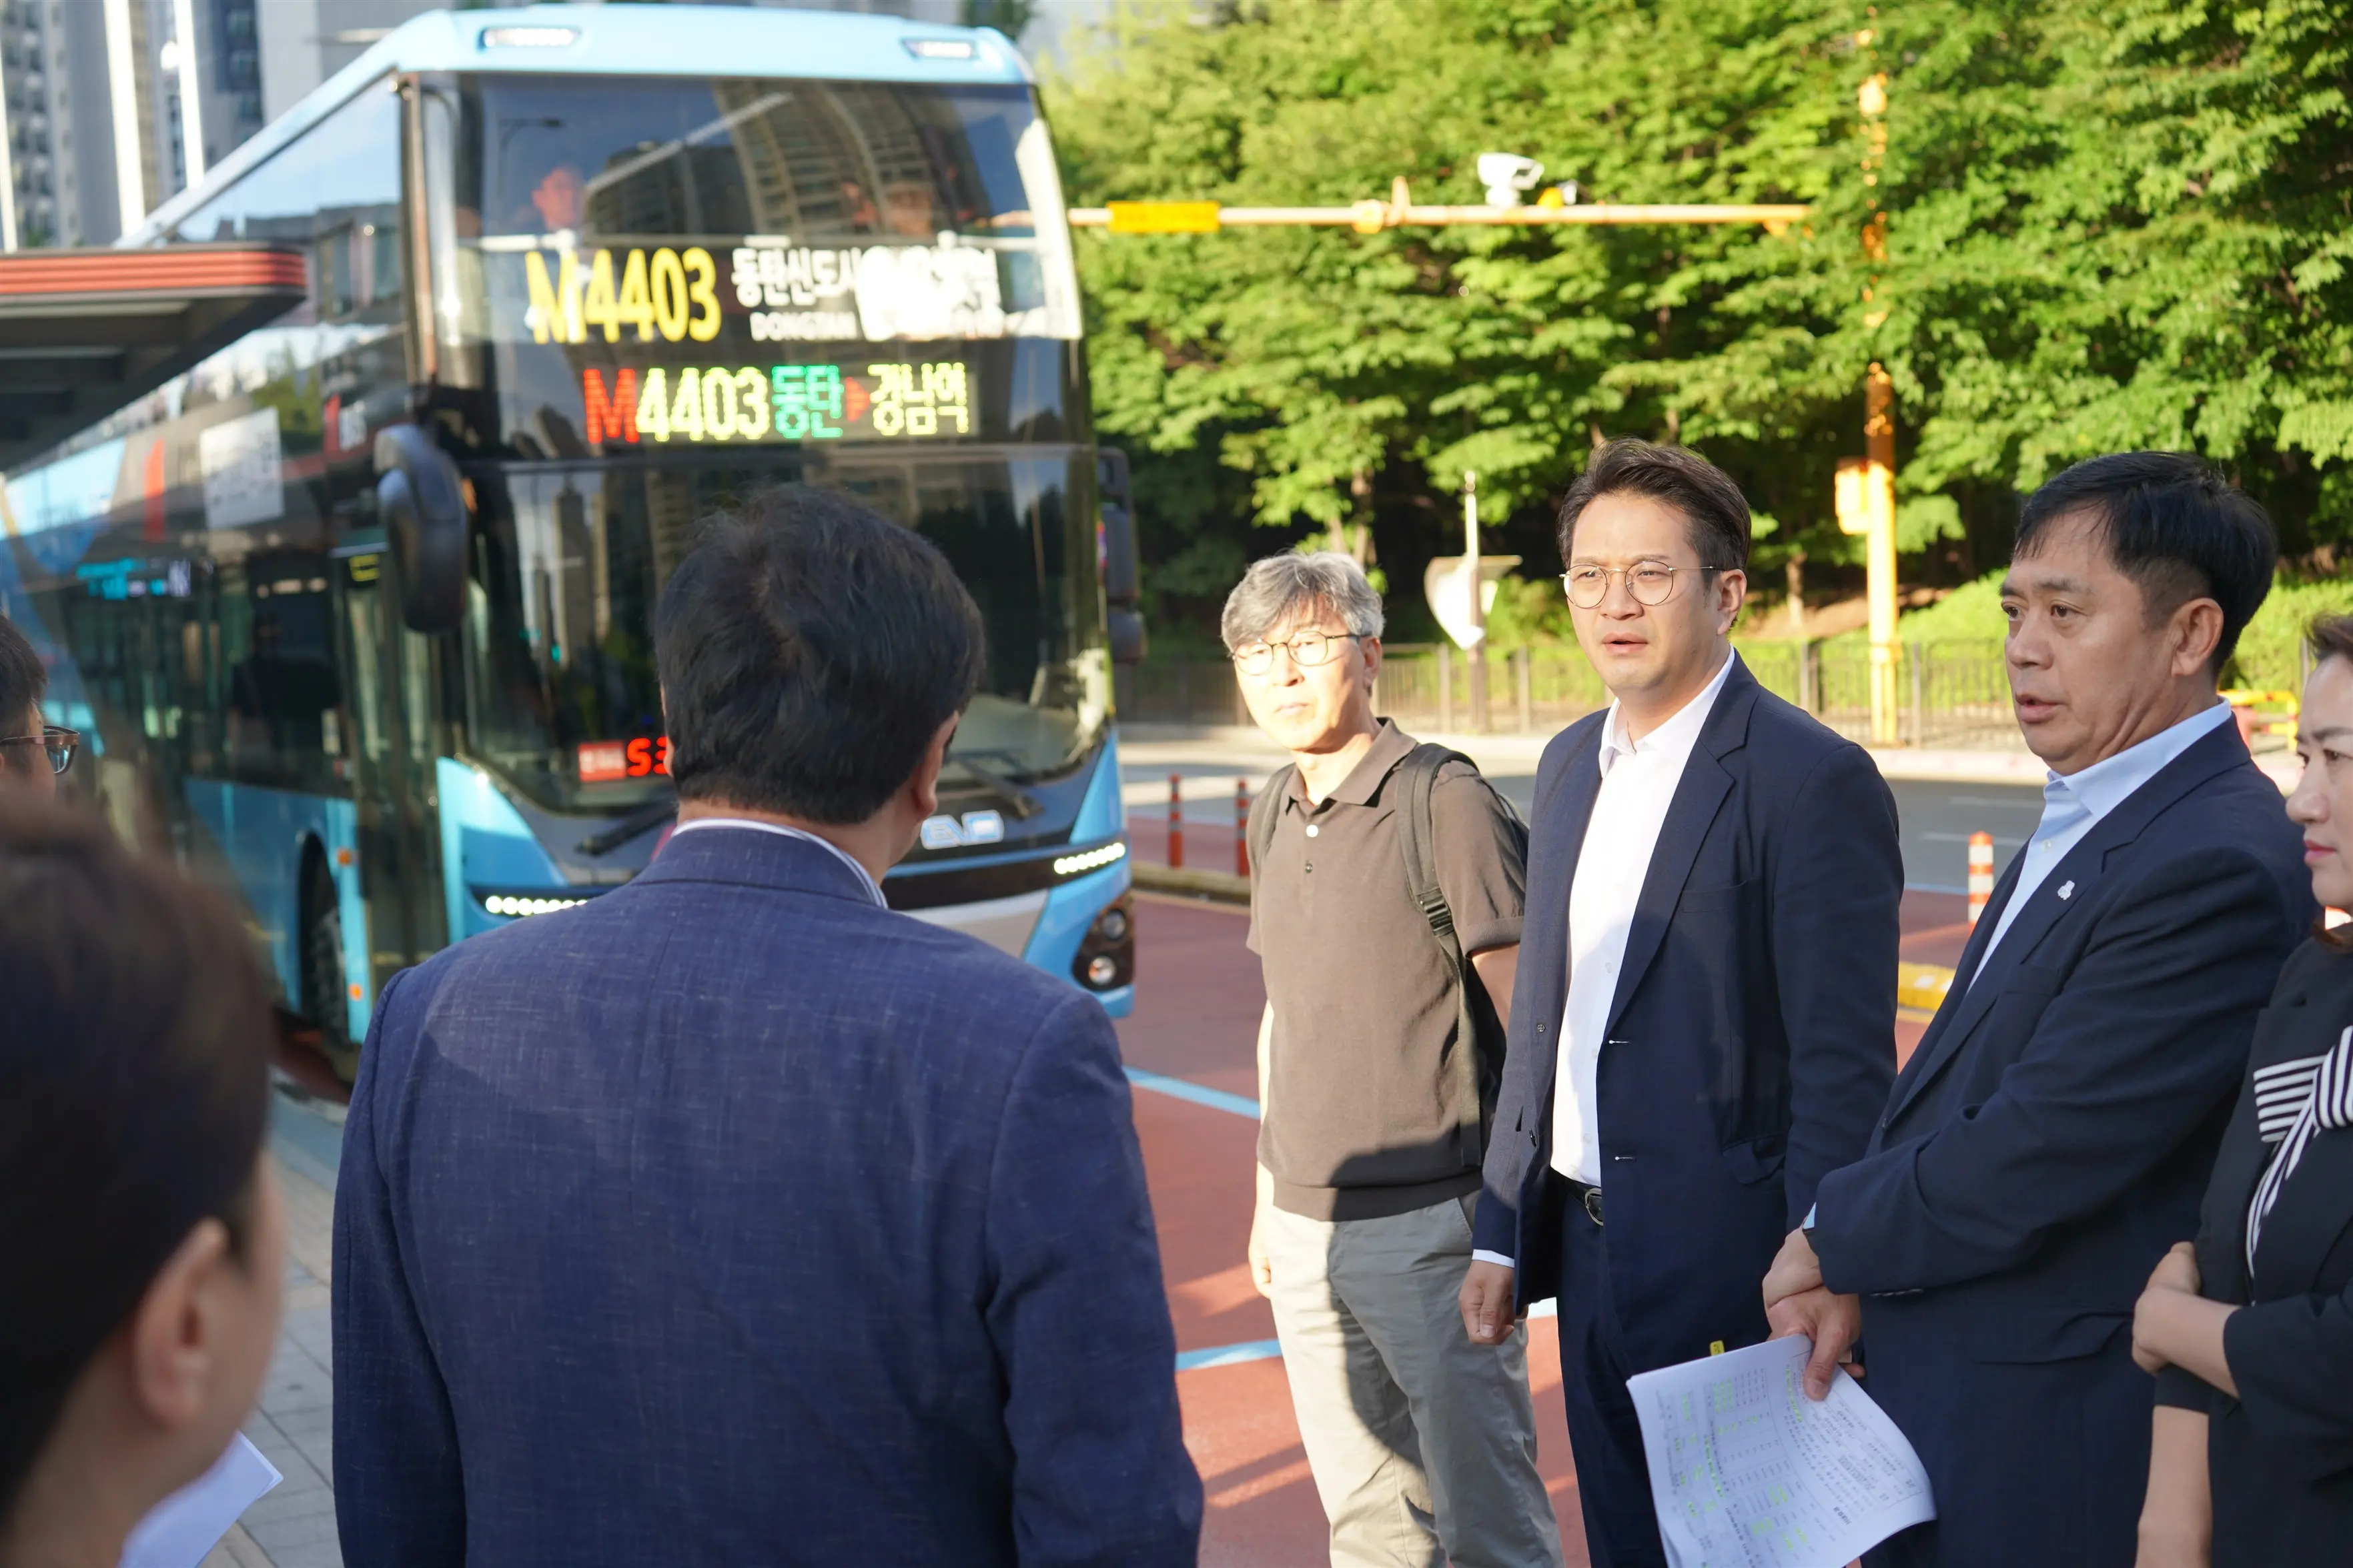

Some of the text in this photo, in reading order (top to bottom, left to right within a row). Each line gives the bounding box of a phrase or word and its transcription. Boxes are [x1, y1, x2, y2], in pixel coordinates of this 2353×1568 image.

[524, 247, 721, 344] M4403
[584, 362, 969, 444] M4403 동탄 강남역
